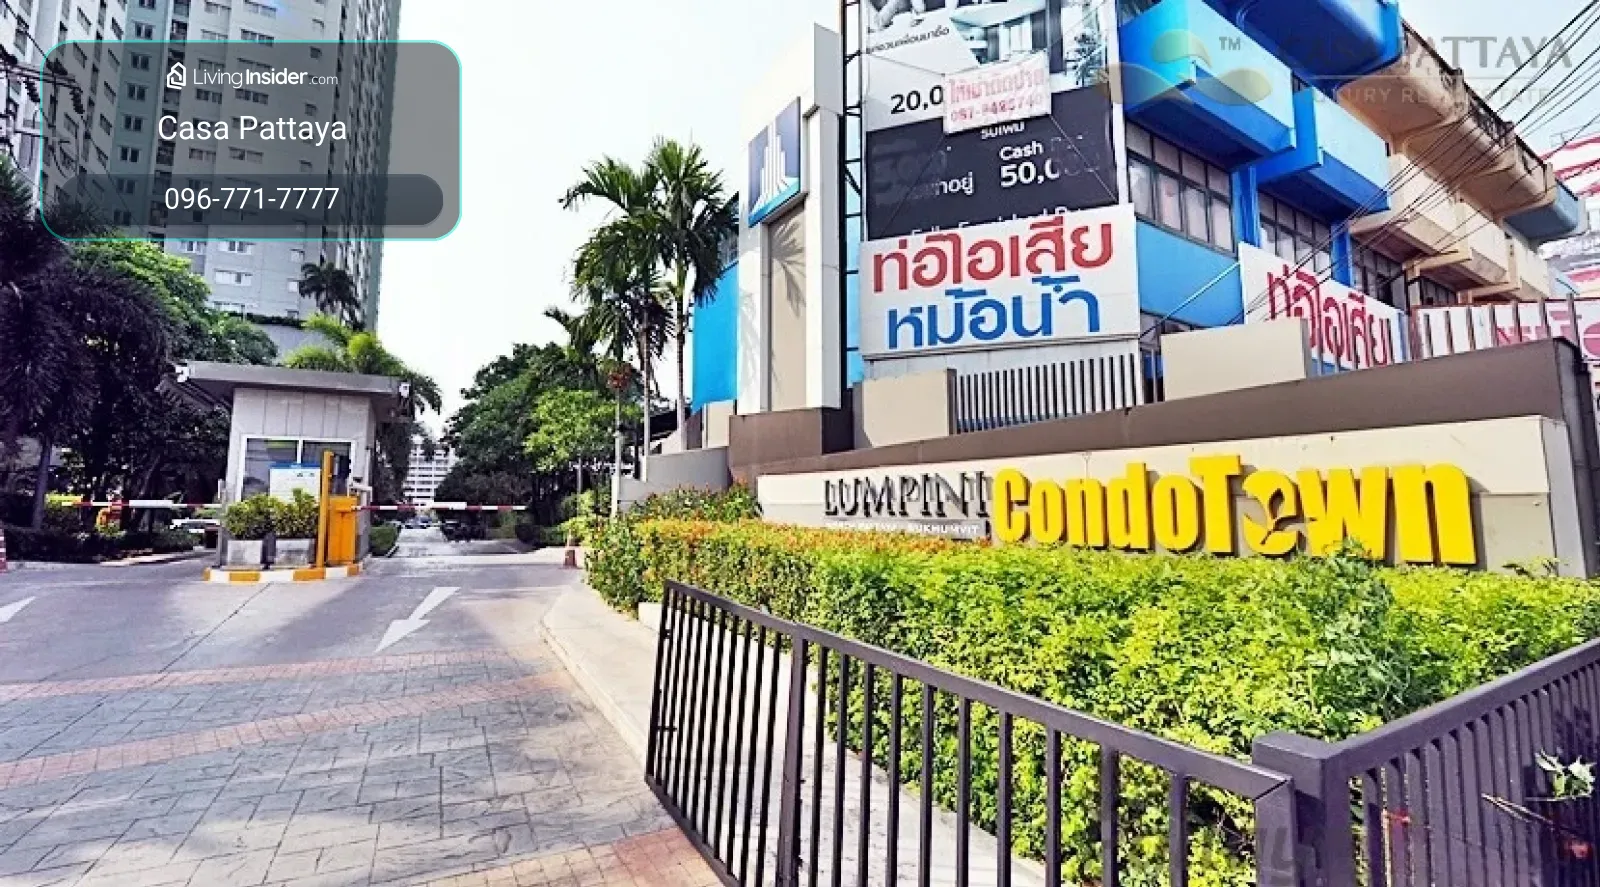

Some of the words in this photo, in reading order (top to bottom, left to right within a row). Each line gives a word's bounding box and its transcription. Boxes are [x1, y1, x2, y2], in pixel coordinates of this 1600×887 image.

[999, 140, 1043, 161] Cash
[873, 215, 1114, 293] ท่อไอเสีย
[888, 275, 1100, 349] หม้อน้ำ
[824, 471, 990, 518] LUMPINI
